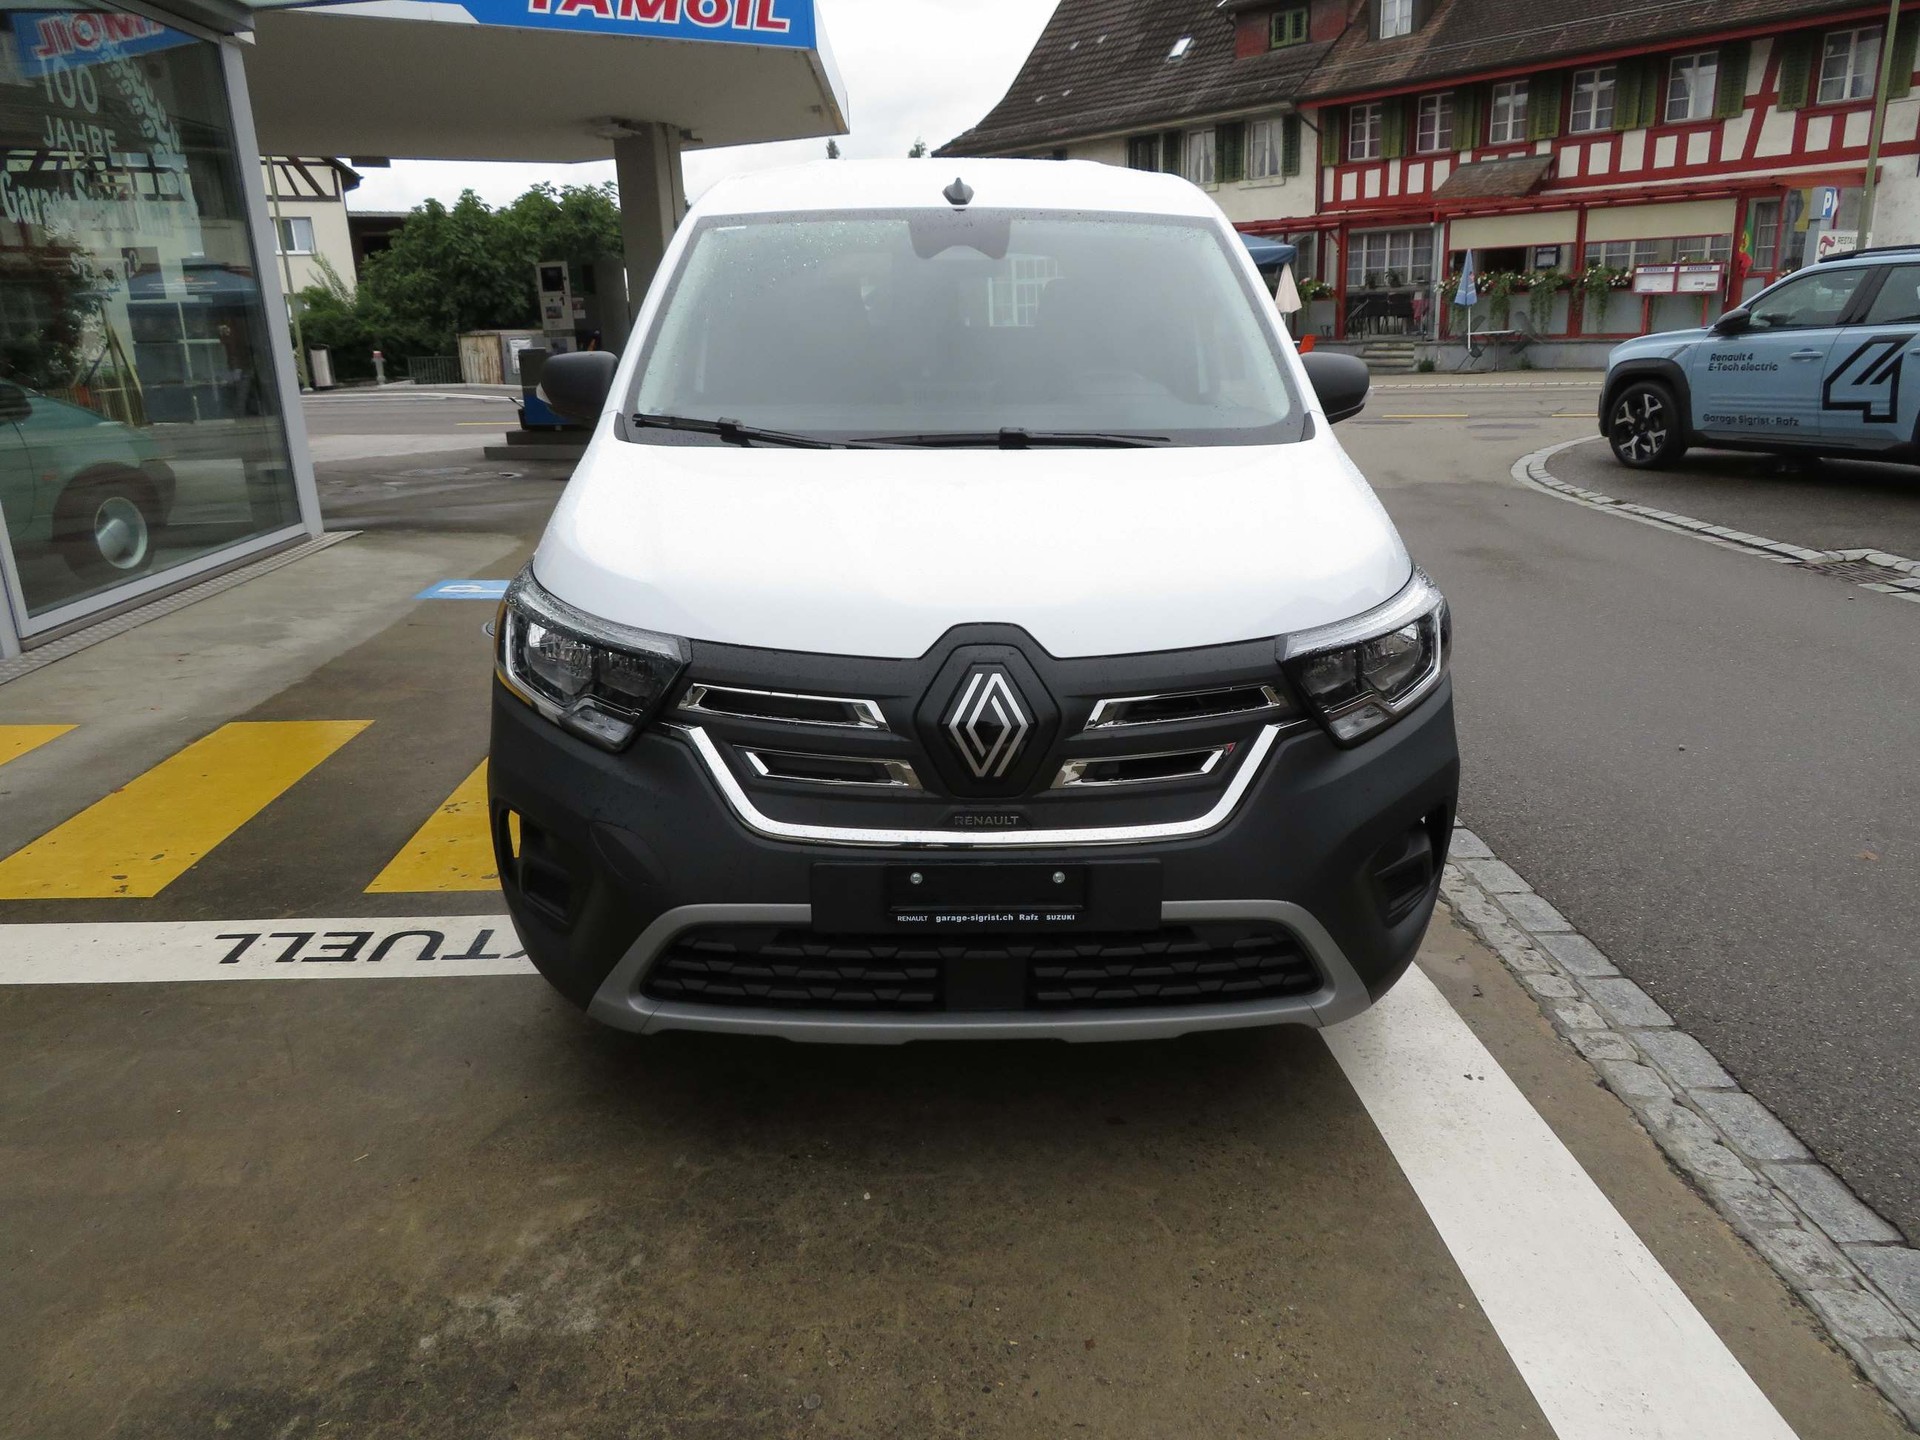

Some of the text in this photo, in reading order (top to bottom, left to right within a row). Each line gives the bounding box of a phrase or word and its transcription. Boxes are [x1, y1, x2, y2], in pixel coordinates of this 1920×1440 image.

[527, 0, 791, 33] MOIL
[41, 56, 99, 114] 100
[43, 115, 119, 153] JAHRE
[1822, 191, 1833, 216] P
[1710, 353, 1754, 362] Renault 4
[1708, 362, 1778, 371] E-Tech electric
[1703, 413, 1737, 425] Garage
[1738, 415, 1769, 426] Sigrist
[1776, 417, 1800, 427] Rafz
[954, 815, 1019, 826] RENAULT
[935, 913, 1014, 923] garage-sigrist.ch
